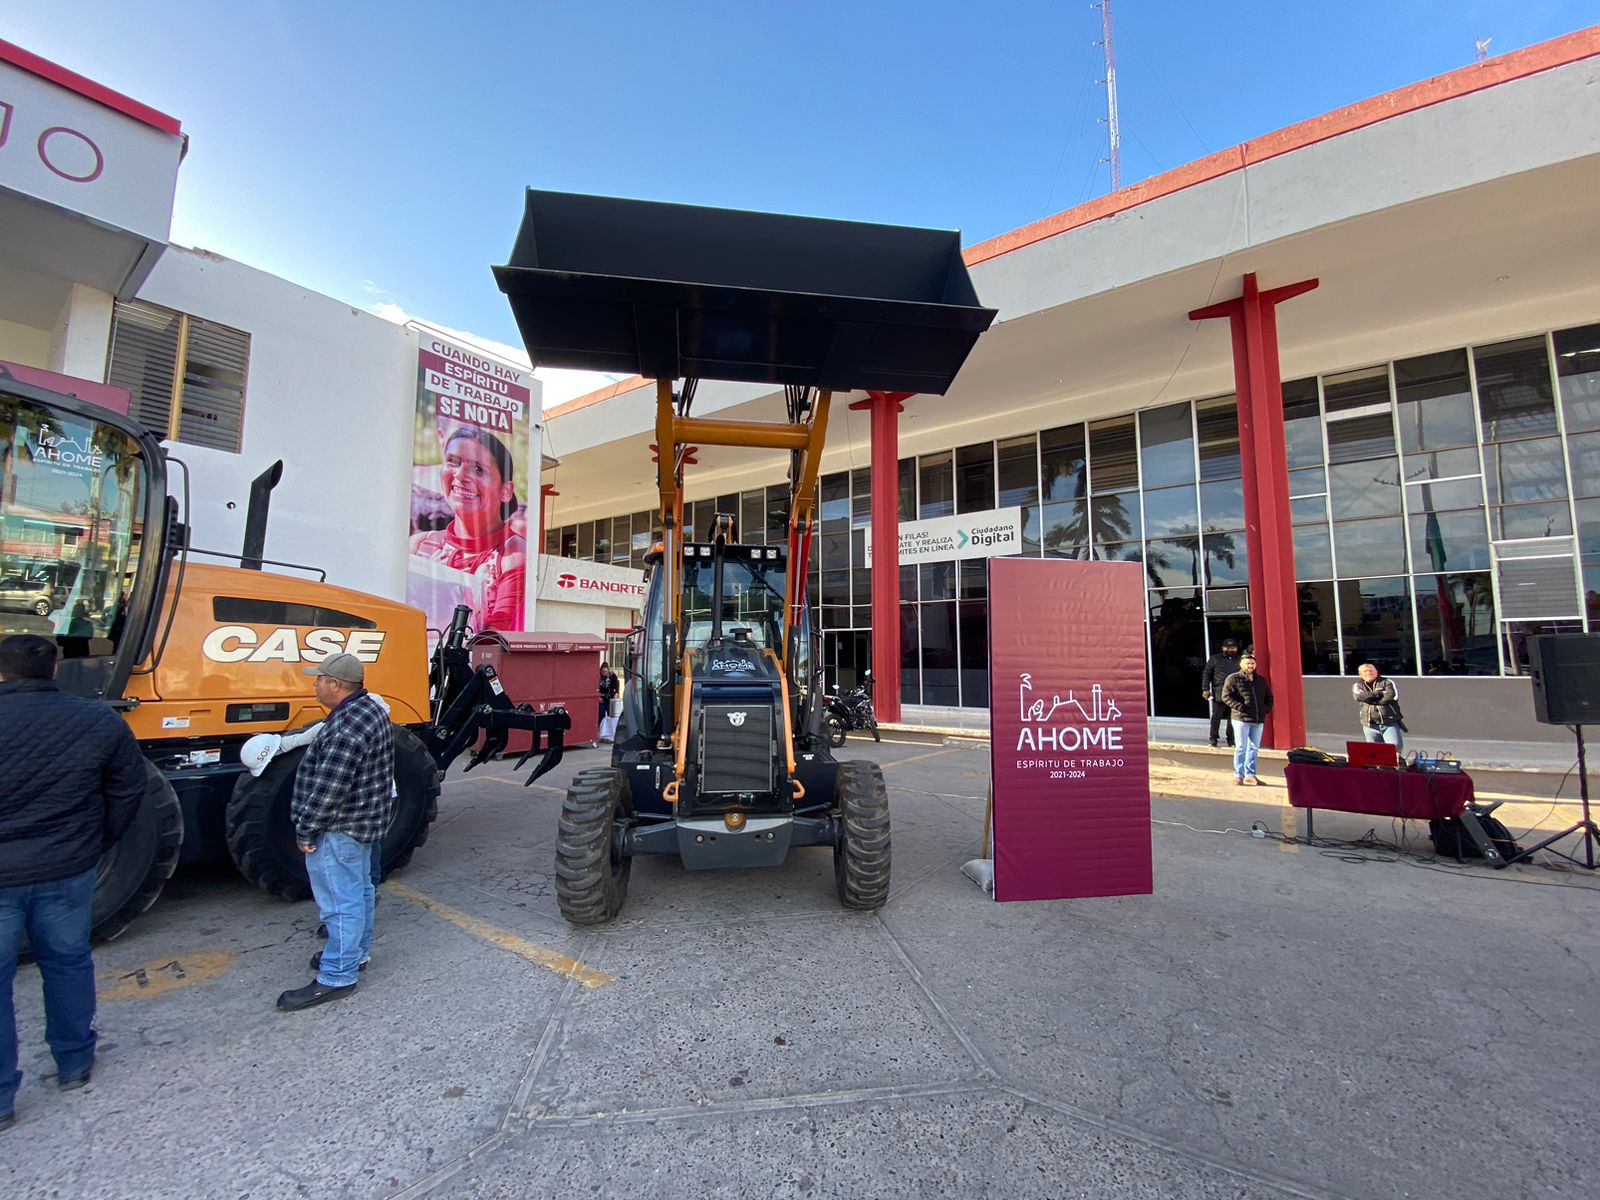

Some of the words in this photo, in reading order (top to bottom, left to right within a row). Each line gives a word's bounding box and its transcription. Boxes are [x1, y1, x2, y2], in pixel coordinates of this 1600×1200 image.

[431, 341, 491, 372] CUANDO
[494, 365, 520, 383] HAY
[444, 361, 508, 394] ESPÍRITU
[431, 373, 450, 390] DE
[455, 382, 519, 412] TRABAJO
[440, 396, 460, 418] SE
[464, 402, 509, 430] NOTA
[34, 446, 102, 468] AHOME
[904, 531, 929, 542] FILAS!
[971, 525, 1014, 535] Ciudadano
[971, 531, 1014, 546] Digital
[921, 536, 954, 546] REALIZA
[919, 546, 930, 554] EN
[579, 578, 645, 595] BANORTE
[202, 625, 386, 663] CASE
[1016, 726, 1124, 751] AHOME
[256, 745, 271, 762] SOP
[1016, 758, 1060, 769] ESPÍRITU
[1063, 759, 1076, 768] DE
[1080, 758, 1124, 768] TRABAJO
[1049, 770, 1086, 779] 2021-2024
